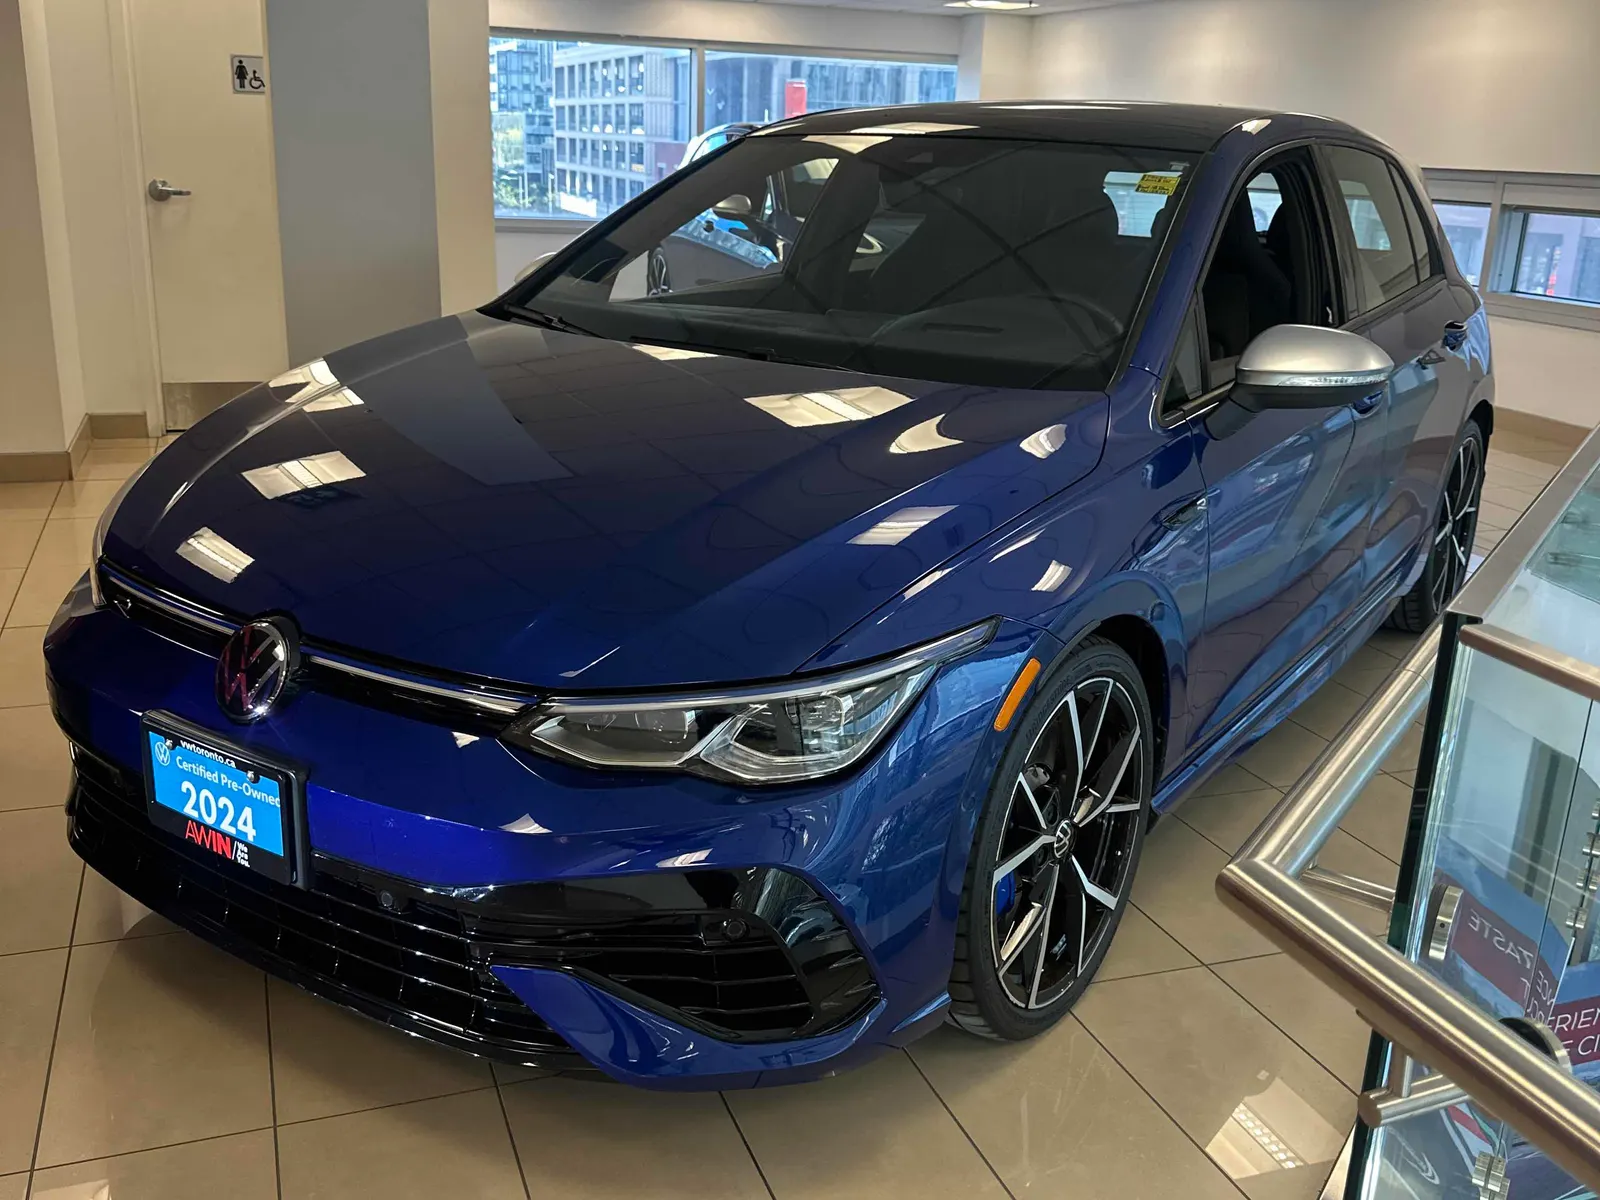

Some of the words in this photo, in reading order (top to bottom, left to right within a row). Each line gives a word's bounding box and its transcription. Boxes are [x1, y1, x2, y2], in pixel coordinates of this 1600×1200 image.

[179, 739, 237, 769] vwtoronto.ca
[175, 755, 219, 784] Certified
[180, 780, 257, 842] 2024
